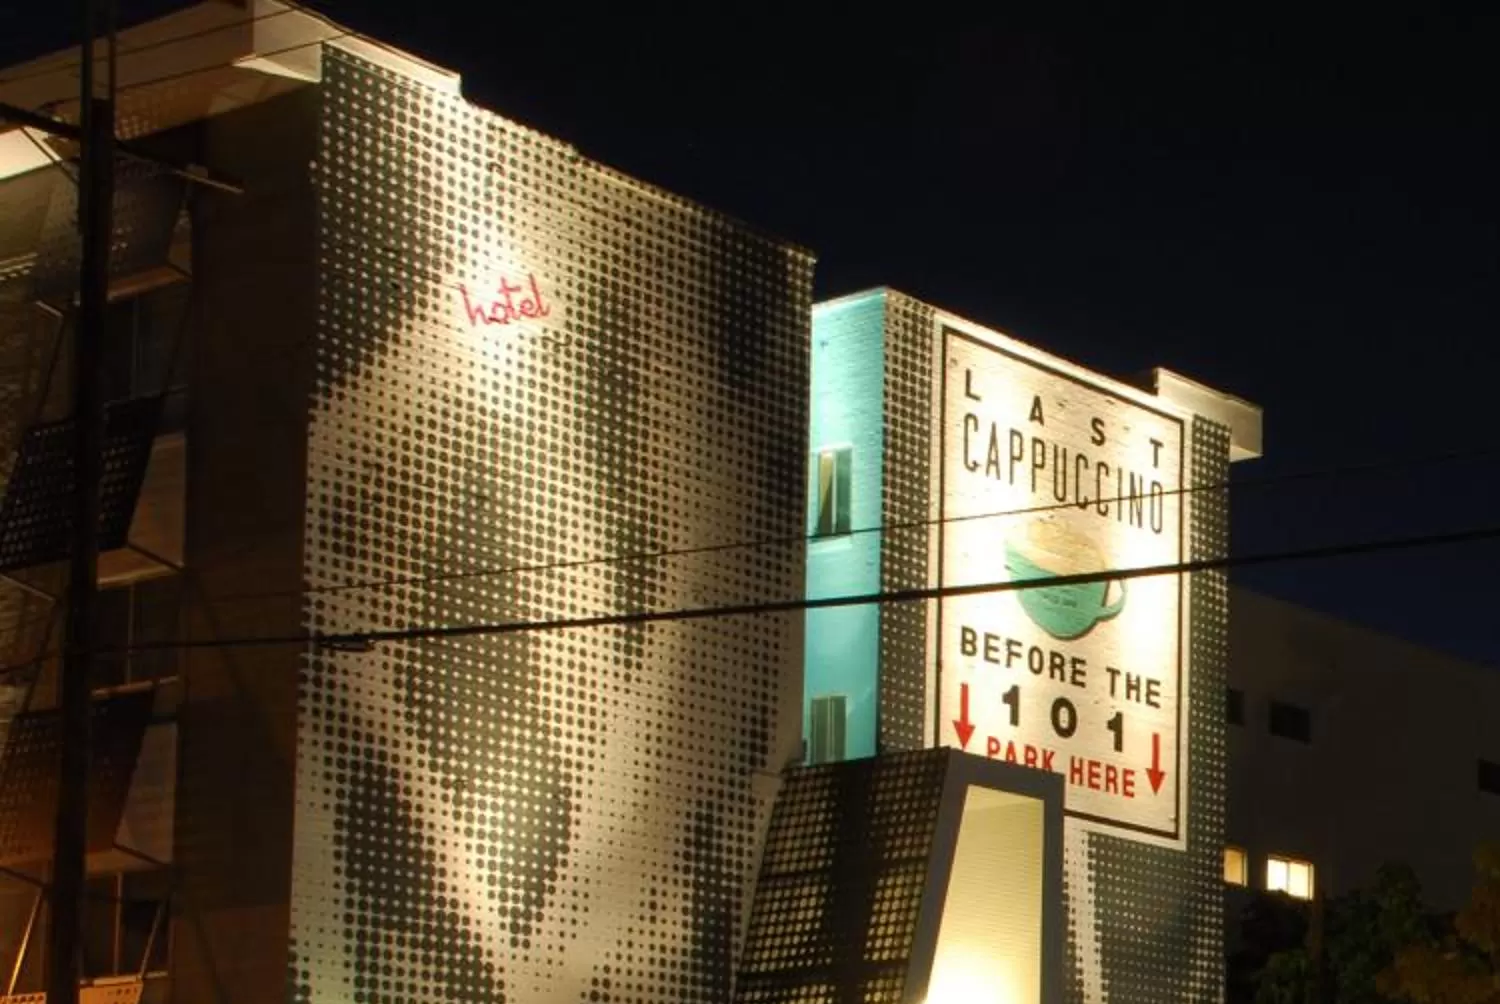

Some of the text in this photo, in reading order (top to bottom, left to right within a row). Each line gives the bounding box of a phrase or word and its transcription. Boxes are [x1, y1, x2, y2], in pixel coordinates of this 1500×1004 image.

[457, 273, 549, 326] hotel
[964, 368, 1164, 468] LAST
[963, 412, 1163, 534] CAPPUCCINO
[960, 626, 1161, 709] BEFORE THE
[1002, 684, 1123, 752] 101
[987, 735, 1135, 798] PARK HERE
